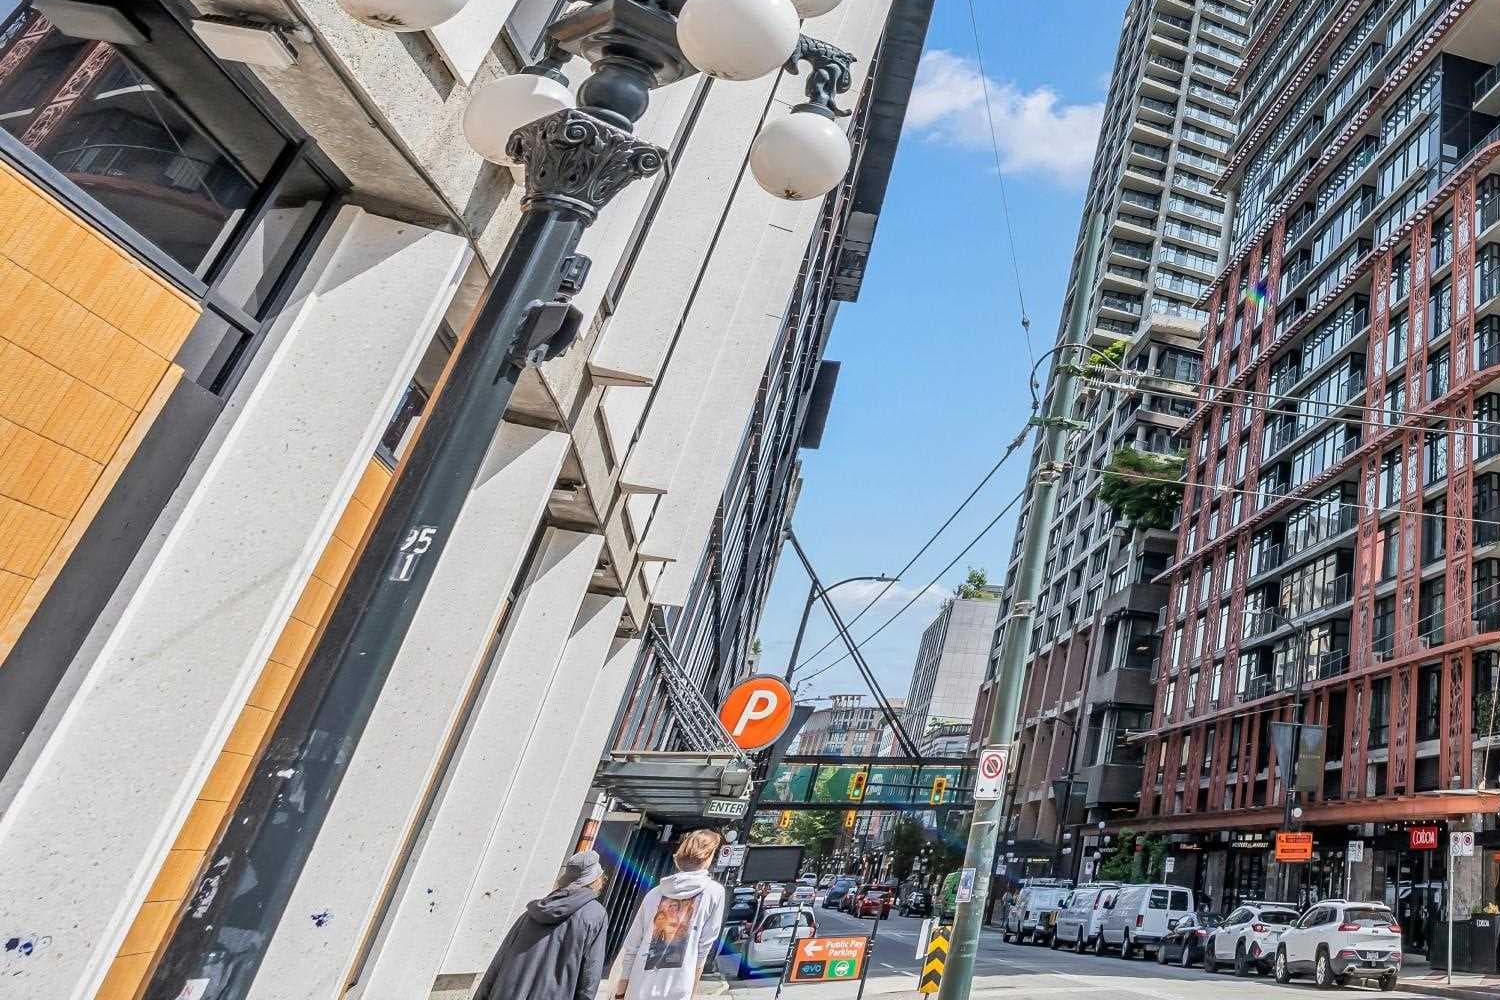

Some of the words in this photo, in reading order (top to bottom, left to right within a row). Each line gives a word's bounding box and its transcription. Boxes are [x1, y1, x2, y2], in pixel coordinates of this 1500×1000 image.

[732, 689, 778, 737] P
[709, 801, 744, 815] ENTER
[803, 964, 822, 973] evo
